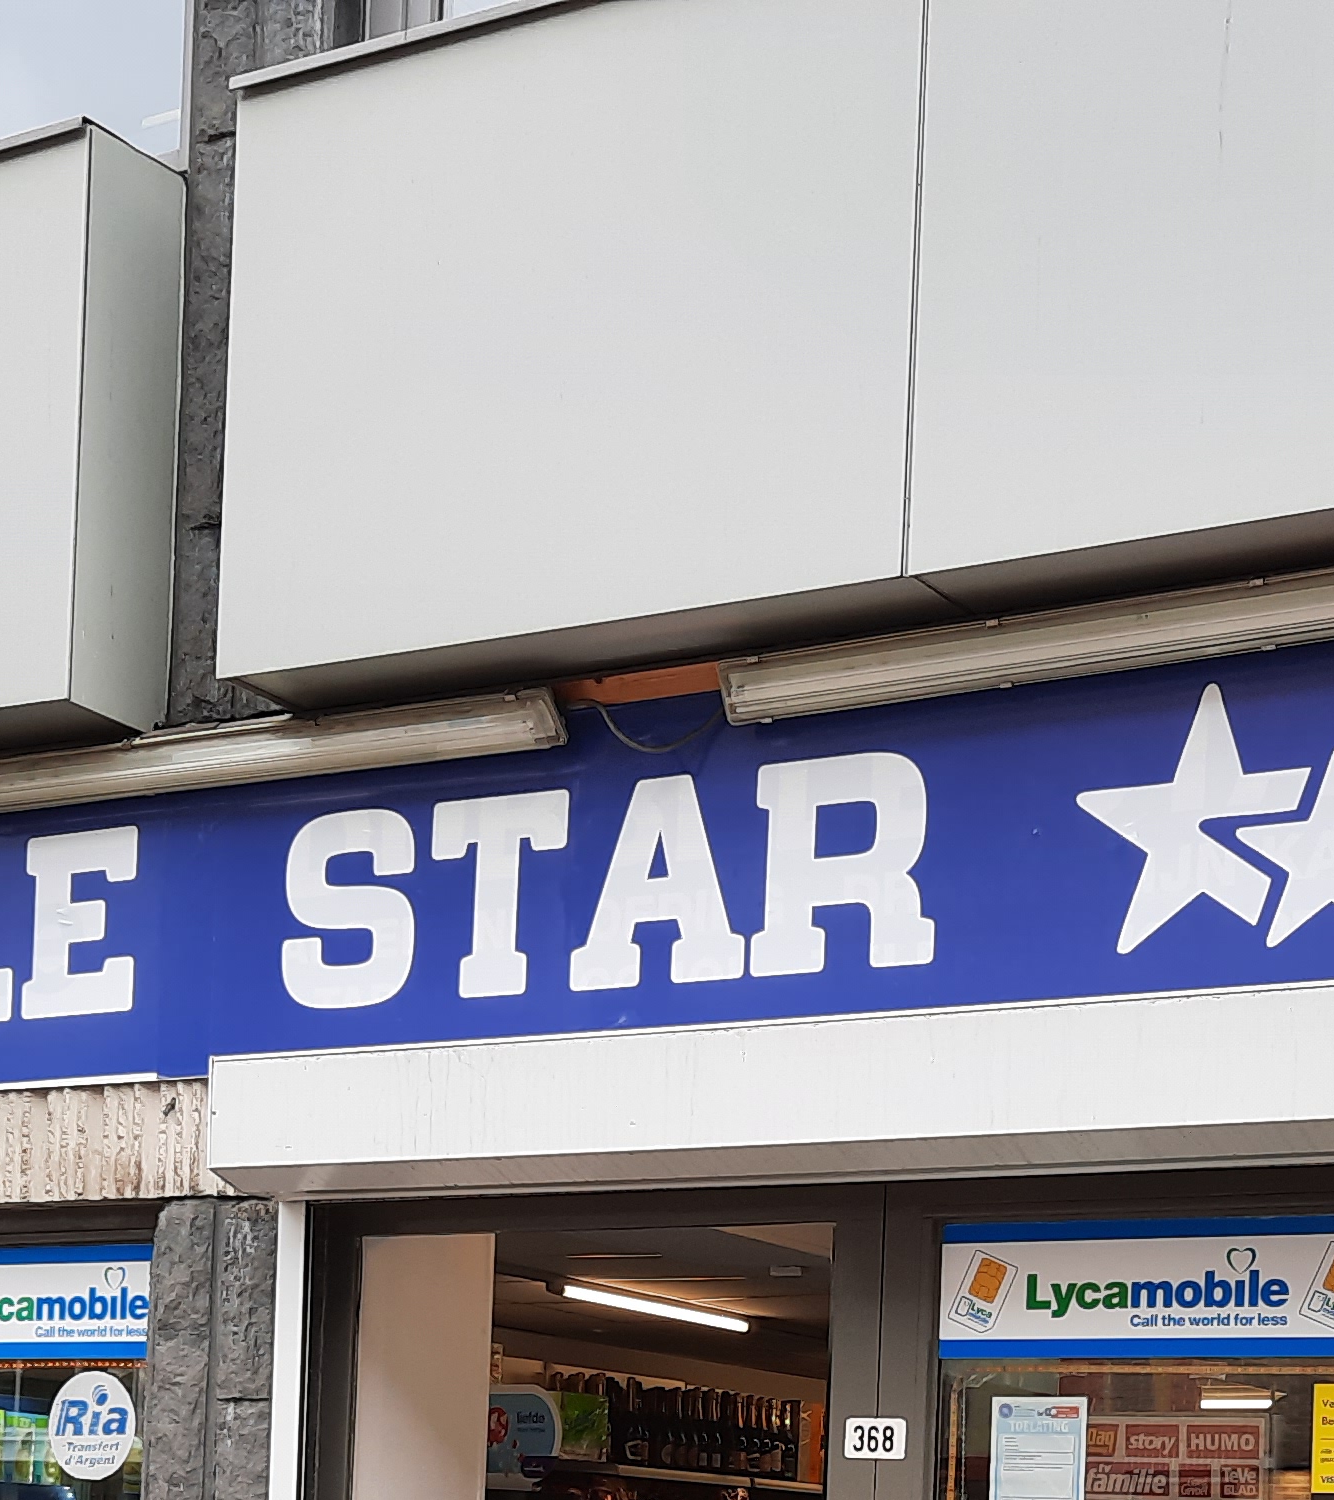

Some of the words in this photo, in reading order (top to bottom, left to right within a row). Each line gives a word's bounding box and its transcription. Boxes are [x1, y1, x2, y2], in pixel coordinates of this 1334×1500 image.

[281, 751, 937, 1011] STAR
[1026, 1269, 1289, 1318] Lycamobile
[35, 1326, 56, 1338] Call
[57, 1326, 74, 1337] the
[77, 1326, 106, 1337] world
[109, 1326, 124, 1337] for
[126, 1325, 147, 1336] less
[1130, 1314, 1158, 1327] Call
[1161, 1314, 1185, 1326] the
[1188, 1313, 1230, 1326] world
[1234, 1313, 1255, 1326] for
[1257, 1313, 1287, 1326] less
[55, 1384, 129, 1436] Ria
[852, 1425, 894, 1452] 368
[1129, 1432, 1176, 1454] story
[1190, 1433, 1255, 1451] HUMO
[1086, 1468, 1166, 1493] familie
